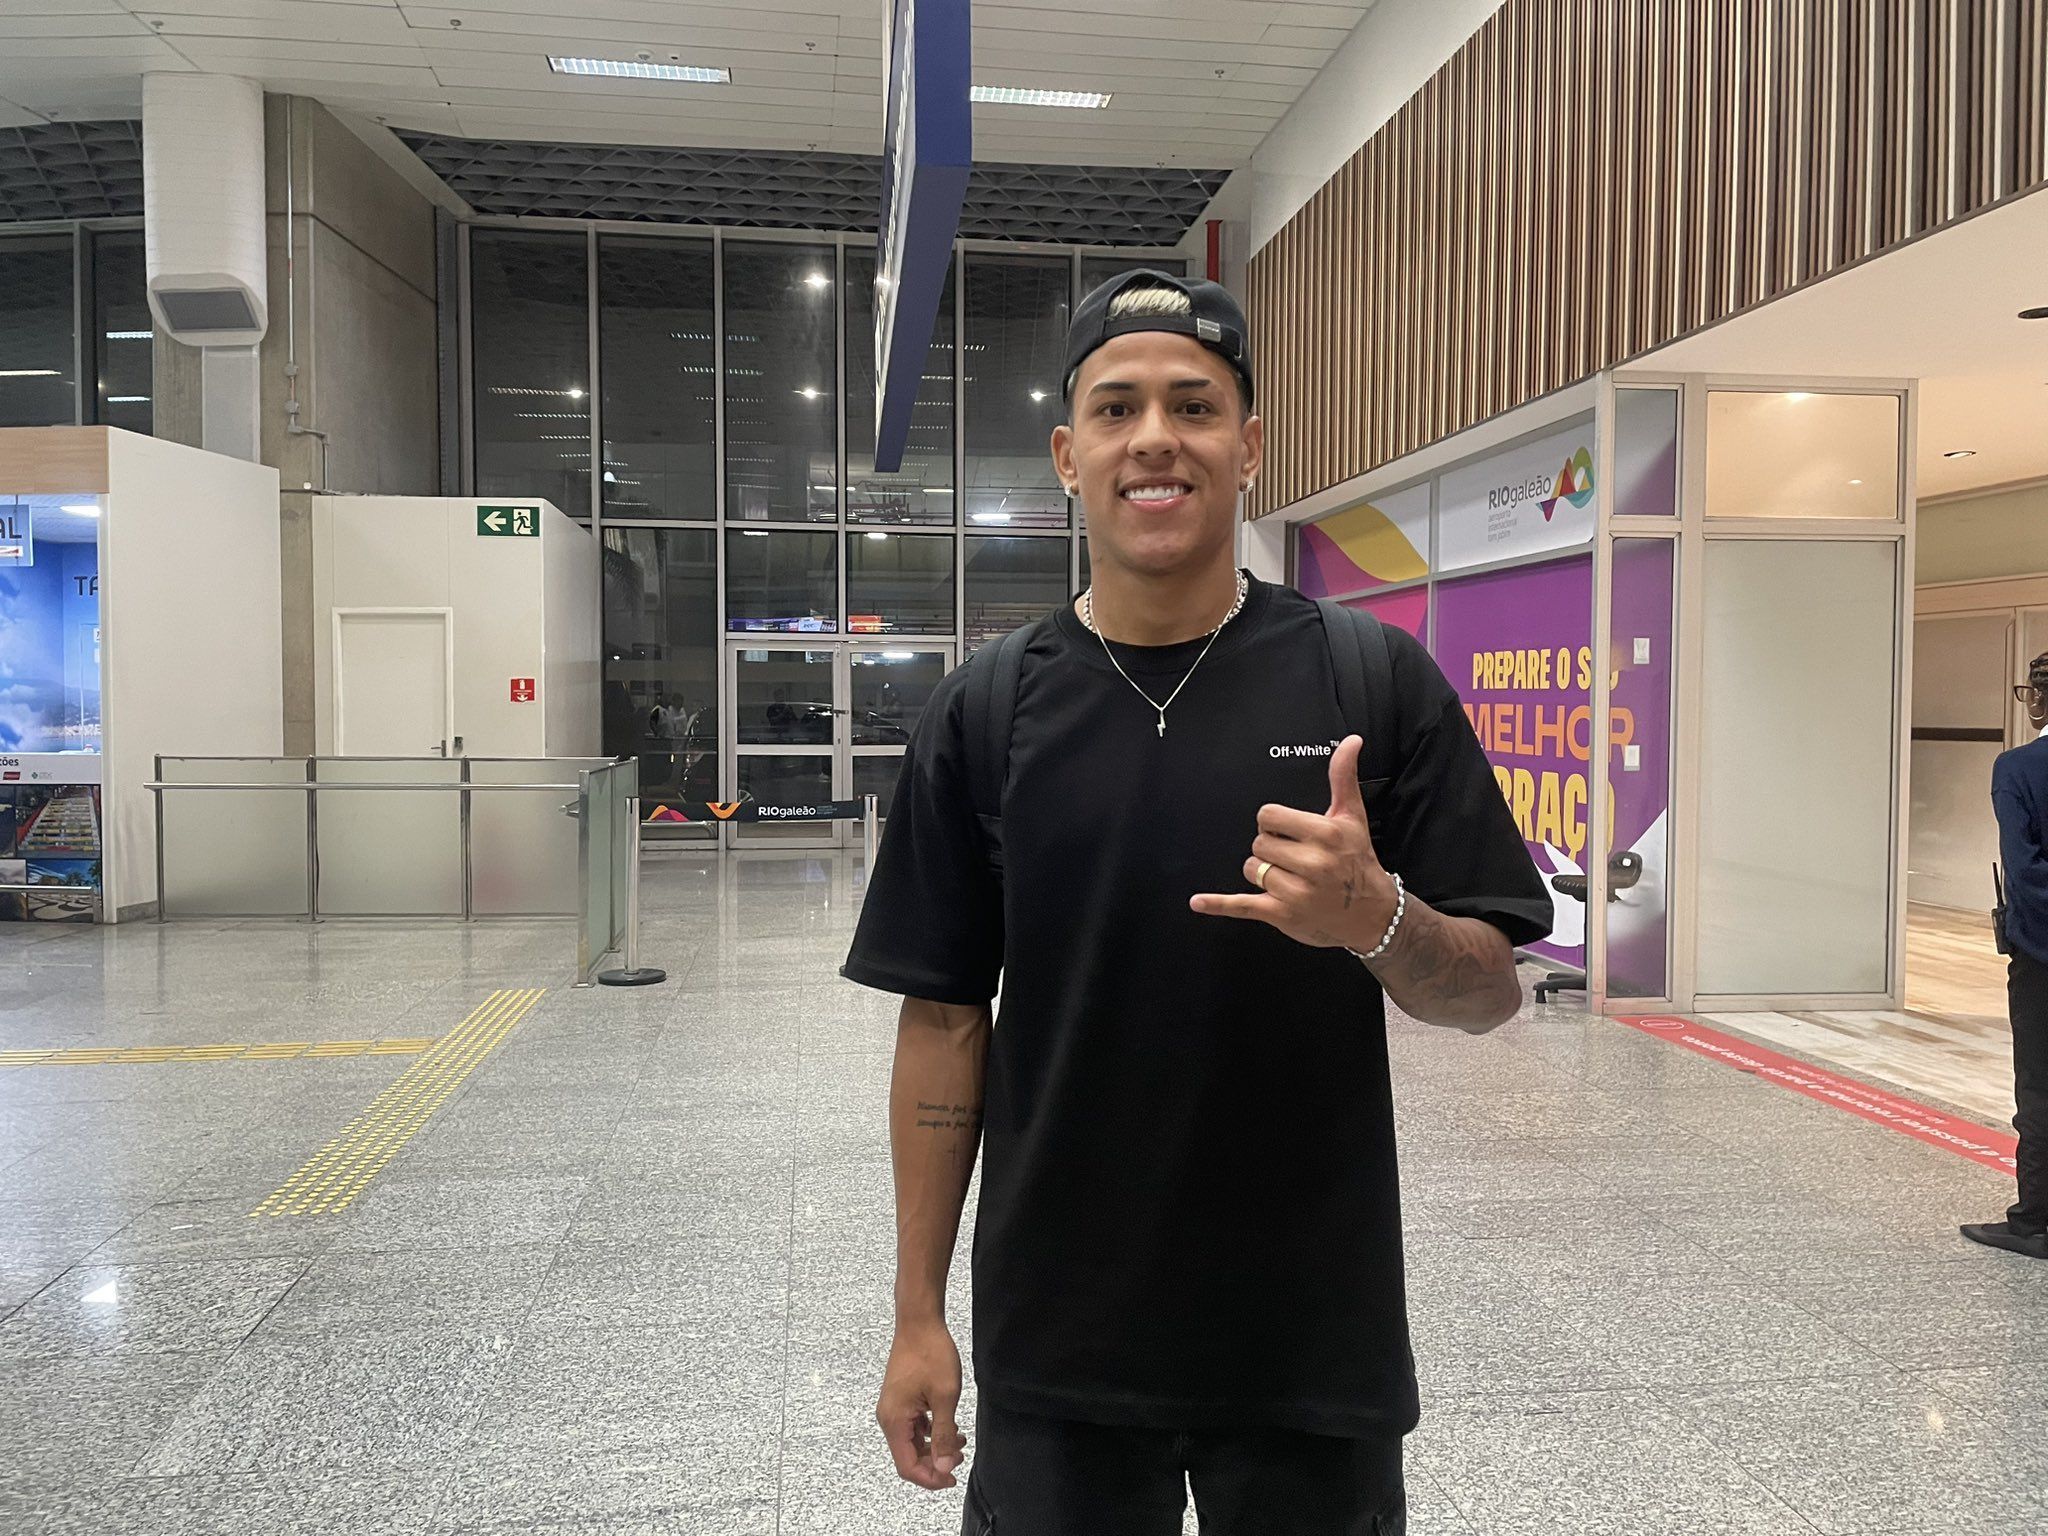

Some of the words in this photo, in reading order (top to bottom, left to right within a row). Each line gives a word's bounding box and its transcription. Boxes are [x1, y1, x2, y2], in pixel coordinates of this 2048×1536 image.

[1488, 475, 1552, 510] RIOgaleão
[1473, 649, 1550, 690] PREPARE
[1557, 647, 1571, 690] O
[0, 756, 19, 766] ões
[758, 806, 816, 818] RIOgaleão
